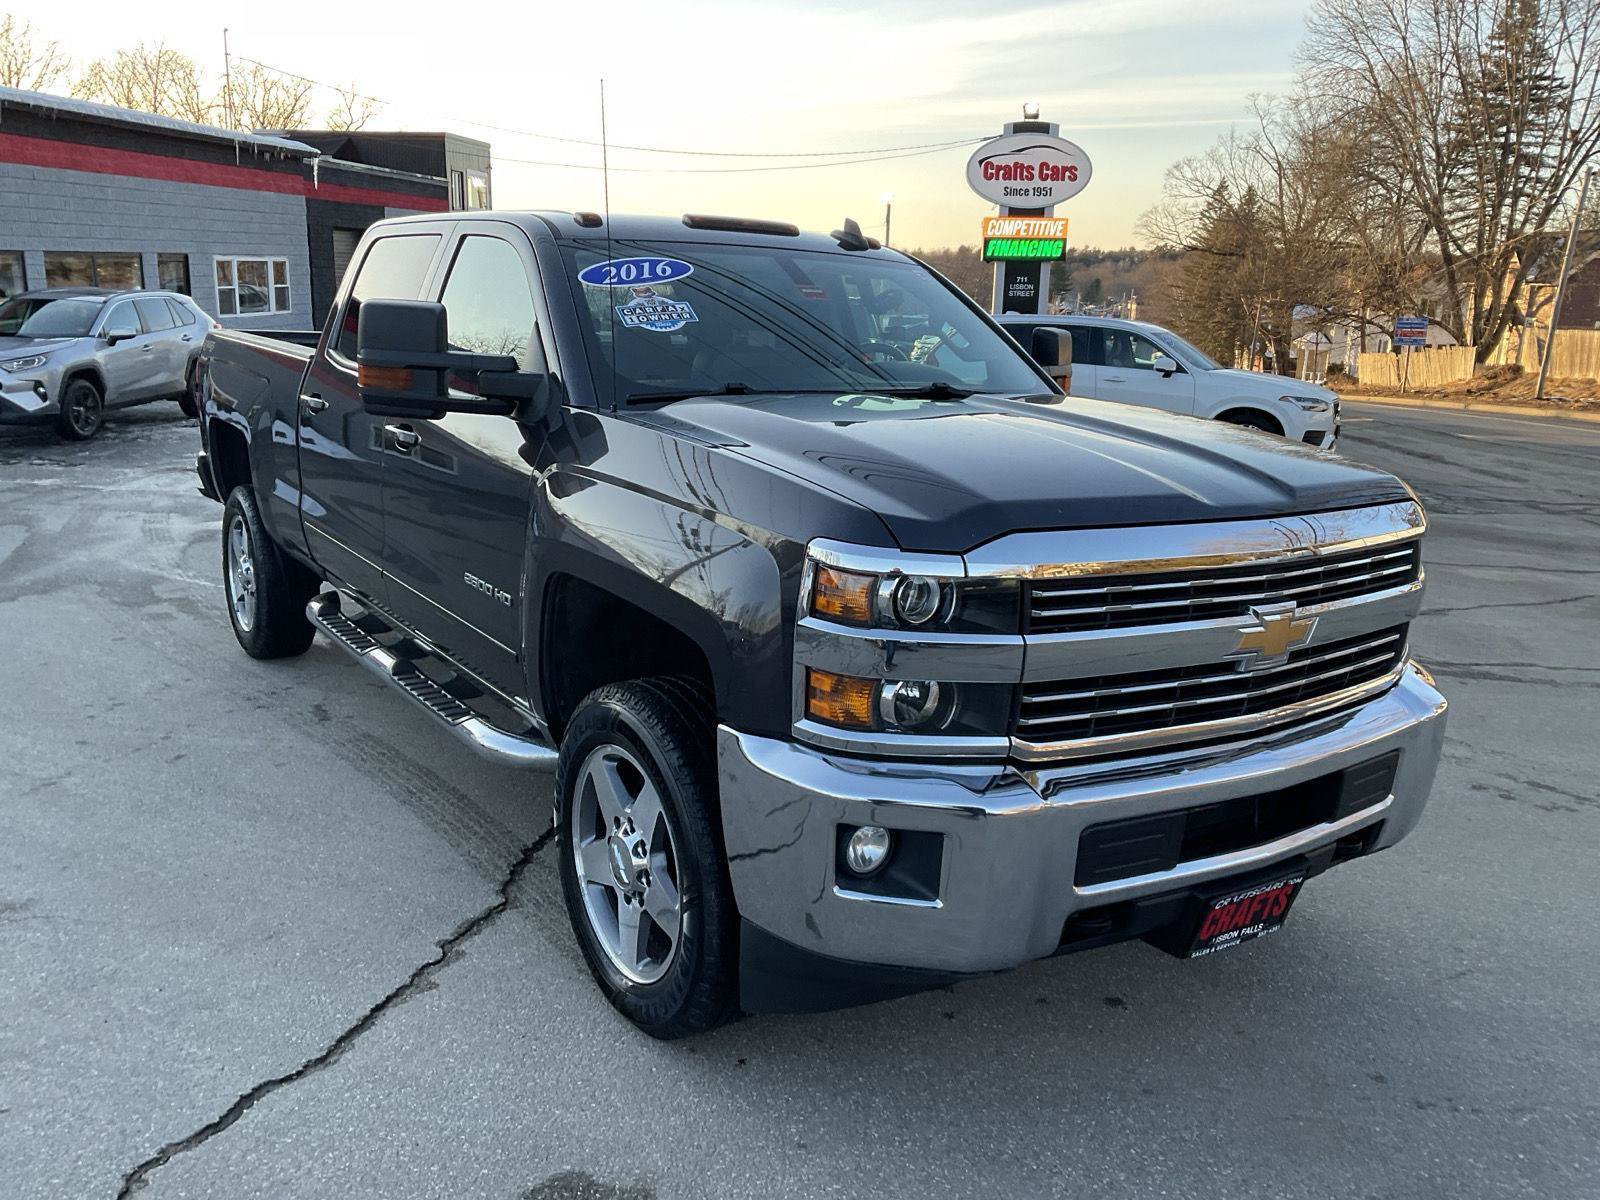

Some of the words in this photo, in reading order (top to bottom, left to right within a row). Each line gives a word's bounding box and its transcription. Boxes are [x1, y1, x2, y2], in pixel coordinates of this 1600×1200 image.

[983, 161, 1035, 181] Crafts
[1038, 161, 1078, 182] Cars
[1003, 186, 1030, 197] Since
[1032, 186, 1053, 197] 1951
[987, 220, 1065, 236] COMPETITIVE
[986, 239, 1064, 257] FINANCING
[602, 261, 672, 284] 2016
[623, 306, 687, 315] CARFAX
[639, 313, 691, 322] OWNER
[1200, 883, 1295, 939] CRAFTS
[1240, 923, 1264, 936] FALLS
